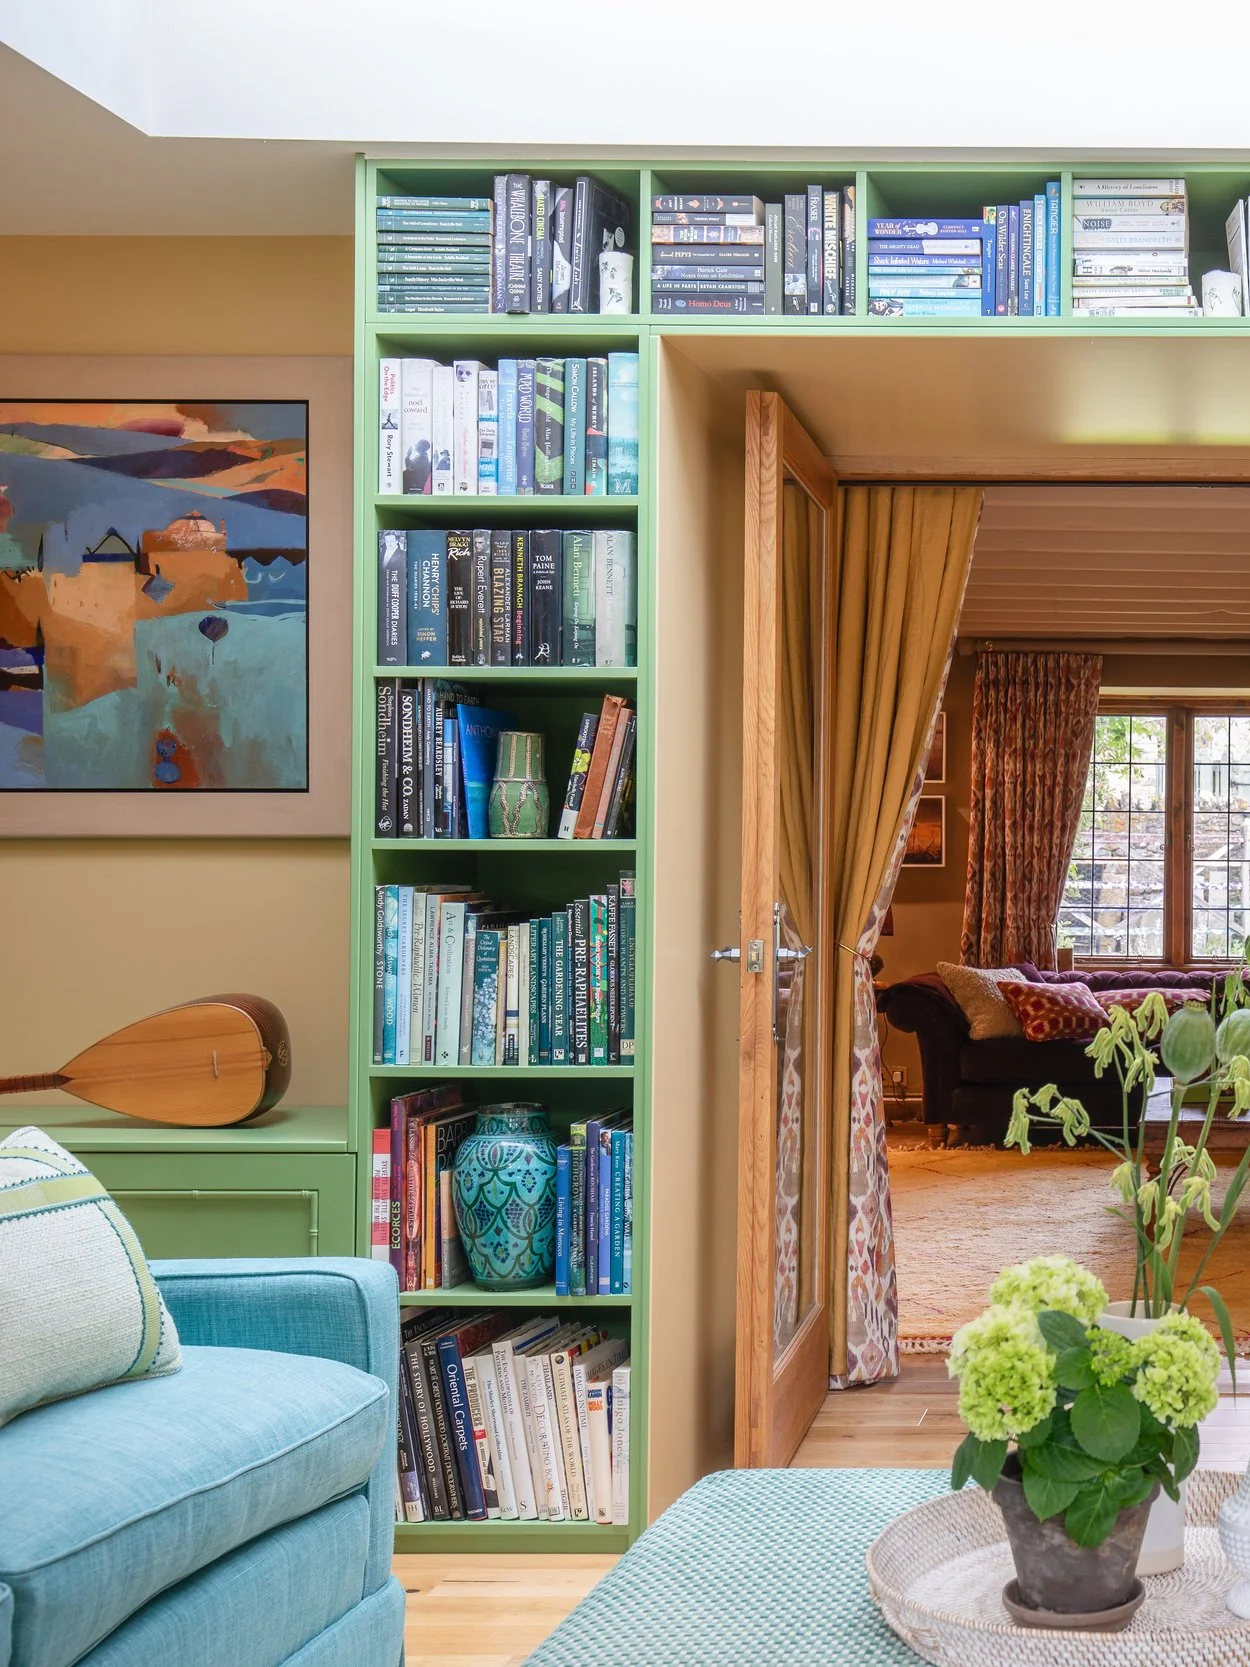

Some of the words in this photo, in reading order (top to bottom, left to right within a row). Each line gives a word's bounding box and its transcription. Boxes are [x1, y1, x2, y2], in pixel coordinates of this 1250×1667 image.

[509, 189, 526, 245] WHALEBONE
[824, 194, 837, 229] WHITE
[998, 210, 1007, 224] On
[1050, 198, 1059, 234] TANGIER
[1082, 219, 1112, 230] NOISE
[536, 218, 545, 240] CINEMA
[998, 225, 1006, 252] Wilder
[824, 230, 837, 279] MISCHIEF
[1023, 214, 1032, 276] NIGHTINGALE
[509, 253, 525, 282] THEATRE
[998, 253, 1006, 270] Seas
[688, 300, 712, 308] Homo
[383, 366, 389, 375] On
[518, 373, 532, 394] MAD
[571, 364, 580, 385] SIMON
[518, 396, 532, 423] WORLD
[571, 386, 579, 413] CALLOW
[516, 536, 524, 572] KENNETH
[573, 535, 582, 558] Alan
[431, 553, 440, 584] HENRY
[476, 555, 487, 583] Rupert
[573, 561, 582, 597] Bennett
[391, 583, 399, 598] DUFF
[422, 560, 431, 608] CHANNON
[493, 567, 504, 614] BLAZING
[516, 573, 524, 609] BRANAGH
[391, 598, 399, 620] COOPER
[477, 585, 487, 614] Everett
[493, 617, 504, 643] STAR
[515, 610, 523, 645] Beginning
[386, 695, 394, 718] Stephen
[378, 686, 392, 756] Sondheim
[402, 695, 413, 763] SONDHEIM
[435, 707, 443, 735] AUBREY
[402, 765, 412, 775] &
[435, 737, 443, 777] BEARDSLEY
[381, 759, 389, 787] Finishing
[402, 777, 413, 797] CO.
[376, 890, 384, 909] Andy
[608, 895, 616, 923] KAFFE
[375, 909, 384, 956] Goldsworthy
[574, 903, 583, 937] Essential
[412, 922, 424, 980] Pre-Raphaelite
[555, 939, 564, 958] THE
[608, 924, 616, 958] FASSETT
[412, 983, 424, 1013] Women
[555, 960, 564, 1011] GARDENING
[574, 938, 588, 1049] PRE-RAPHAELITES
[554, 1013, 563, 1036] YEAR
[556, 1197, 565, 1219] Living
[391, 1201, 401, 1249] ECORCES
[557, 1219, 565, 1227] in
[556, 1227, 564, 1257] Morocco
[409, 1352, 419, 1370] THE
[413, 1372, 424, 1400] STORY
[418, 1402, 426, 1414] OF
[446, 1364, 460, 1408] Oriental
[453, 1410, 468, 1451] Carpets
[419, 1416, 436, 1473] HOLLYWOOD
